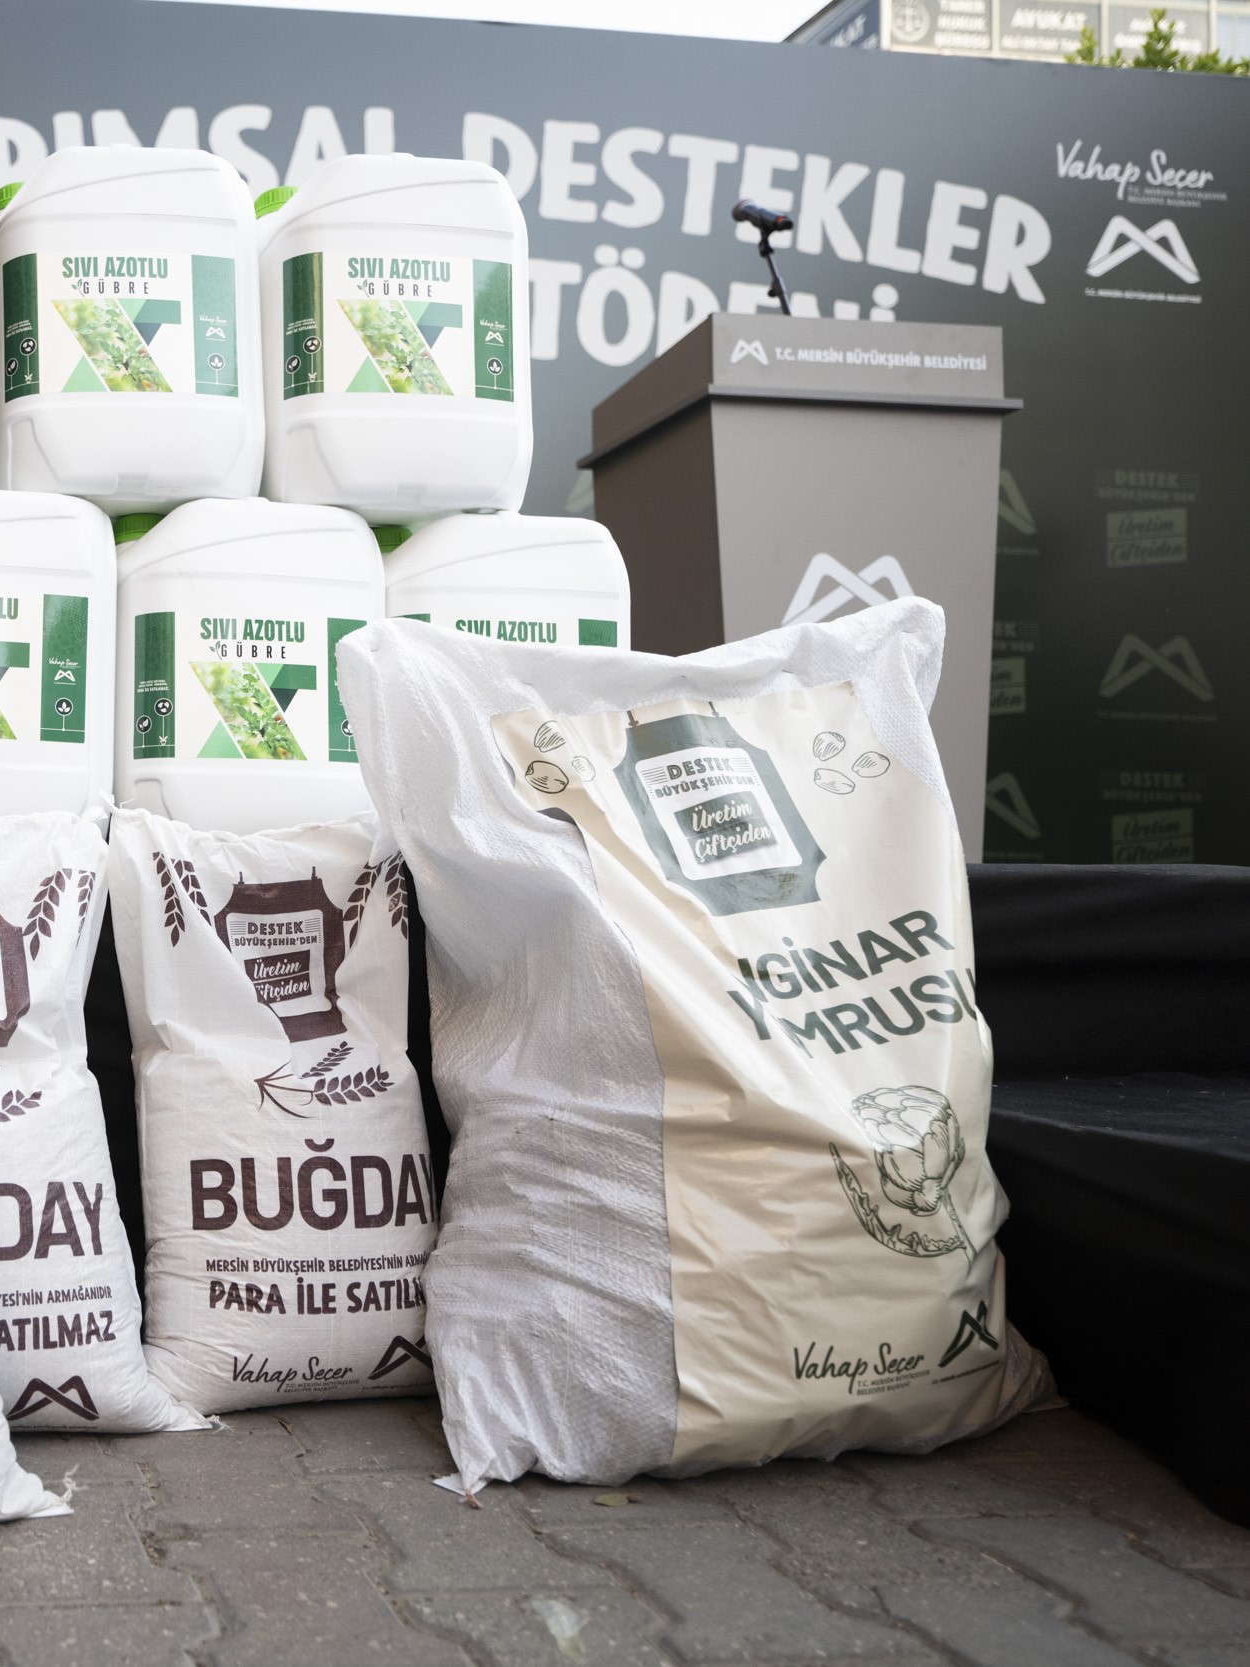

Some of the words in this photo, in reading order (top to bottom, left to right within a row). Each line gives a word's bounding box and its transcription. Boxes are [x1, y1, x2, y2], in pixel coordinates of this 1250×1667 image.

[1056, 138, 1141, 201] Vahap
[1145, 149, 1215, 190] Seçer
[462, 112, 1052, 305] DESTEKLER
[62, 257, 98, 278] SIVI
[104, 257, 169, 279] AZOTLU
[348, 257, 384, 279] SIVI
[389, 258, 451, 283] AZOTLU
[83, 278, 149, 295] GÜBRE
[368, 280, 433, 297] GÜBRE
[798, 346, 843, 364] MERSİN
[846, 348, 921, 369] BÜYÜKŞEHİR
[924, 353, 987, 371] BELEDİYESİ
[200, 617, 237, 640] SIVI
[242, 618, 305, 643] AZOTLU
[496, 620, 557, 644] AZOTLU
[221, 641, 286, 659] GÜBRE
[666, 757, 735, 781] DESTEK
[654, 774, 755, 798] BÜYÜKŞEHİR'DEN
[691, 800, 752, 832] Üretim
[694, 823, 772, 863] Çiftçiden
[247, 921, 304, 936] DESTEK
[234, 935, 318, 949] BÜYÜKŞEHİR'DEN
[253, 959, 301, 979] Üretim
[256, 980, 310, 1001] iftçiden
[206, 1257, 249, 1272] MERSİN
[253, 1257, 326, 1275] BÜYÜKŞEHİR
[329, 1254, 403, 1272] BELEDİYESİ'NİN
[46, 1284, 112, 1304] ARMAĞANIDIR
[209, 1280, 286, 1315] PARA
[297, 1276, 337, 1315] İLE
[232, 1353, 297, 1392] Vahap
[302, 1356, 353, 1382] Seçer
[794, 1341, 869, 1395] Vahap
[873, 1342, 925, 1376] Seçer
